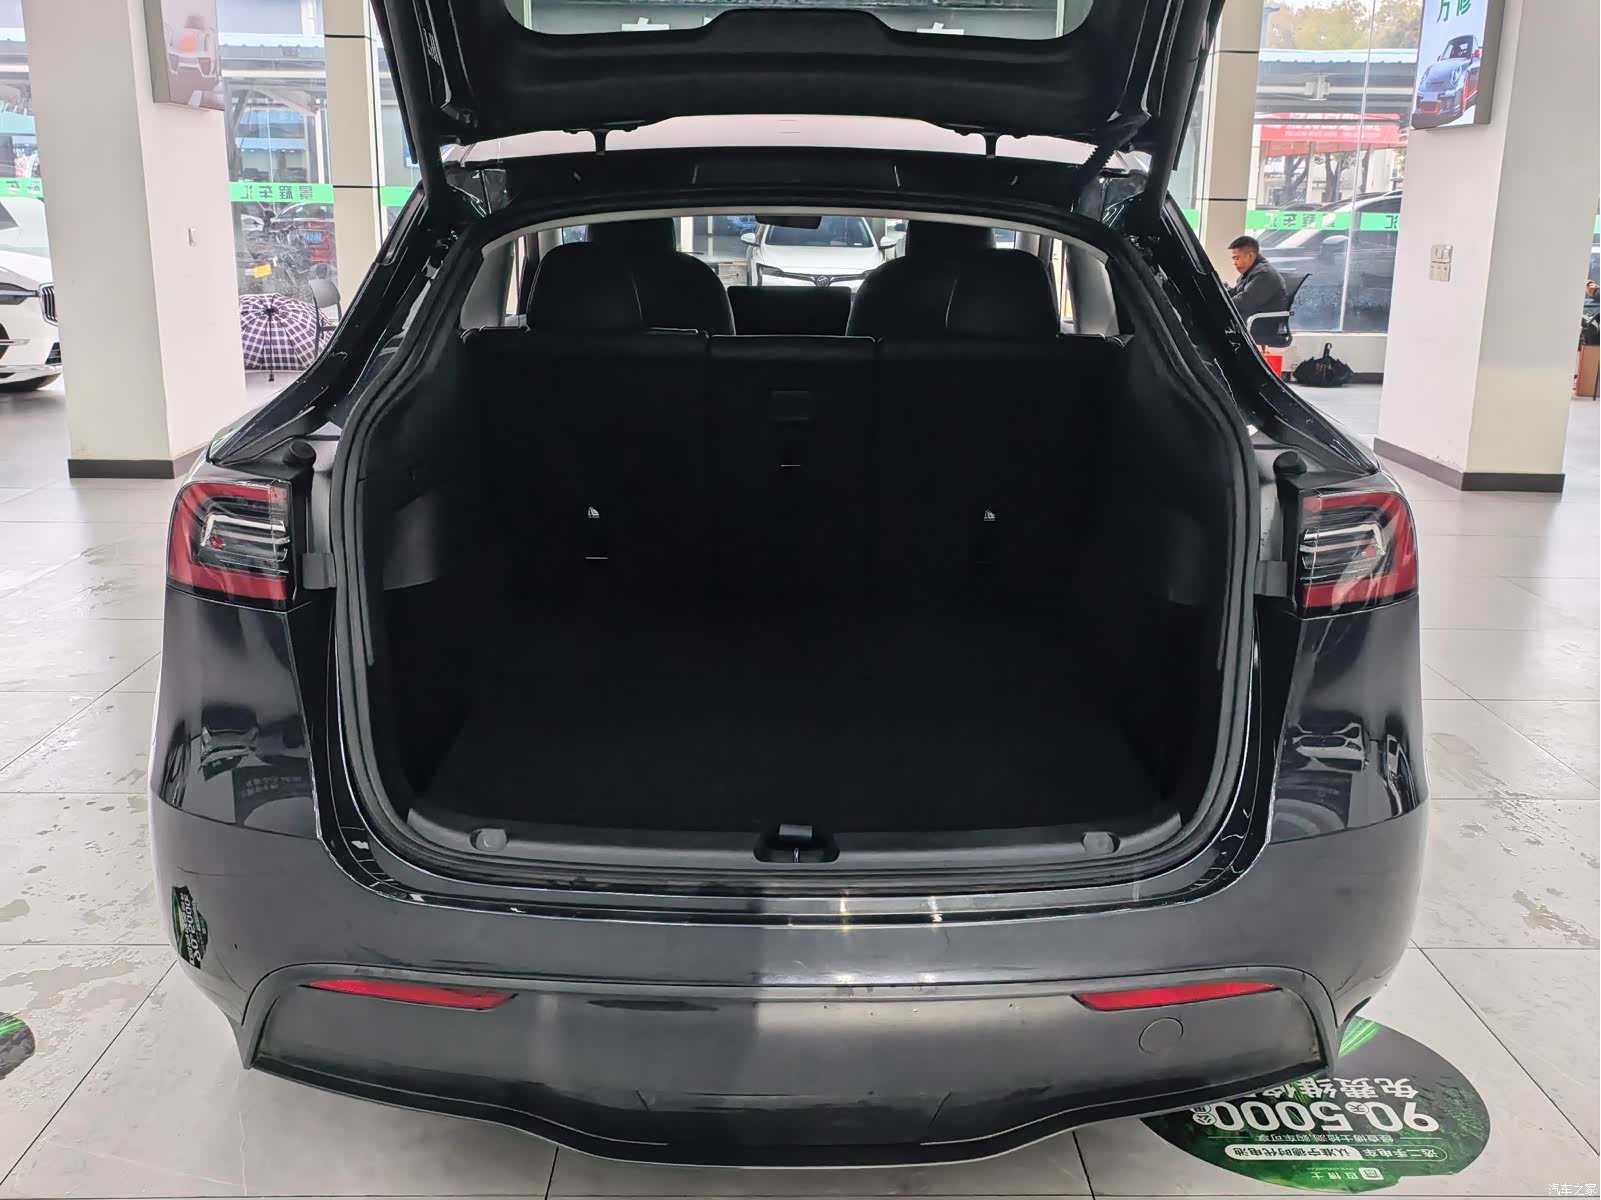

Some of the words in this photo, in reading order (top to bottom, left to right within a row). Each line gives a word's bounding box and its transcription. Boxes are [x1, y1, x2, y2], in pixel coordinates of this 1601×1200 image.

[1233, 1147, 1351, 1158] 认准宁德时代电池
[1363, 1147, 1438, 1159] 选二手电车
